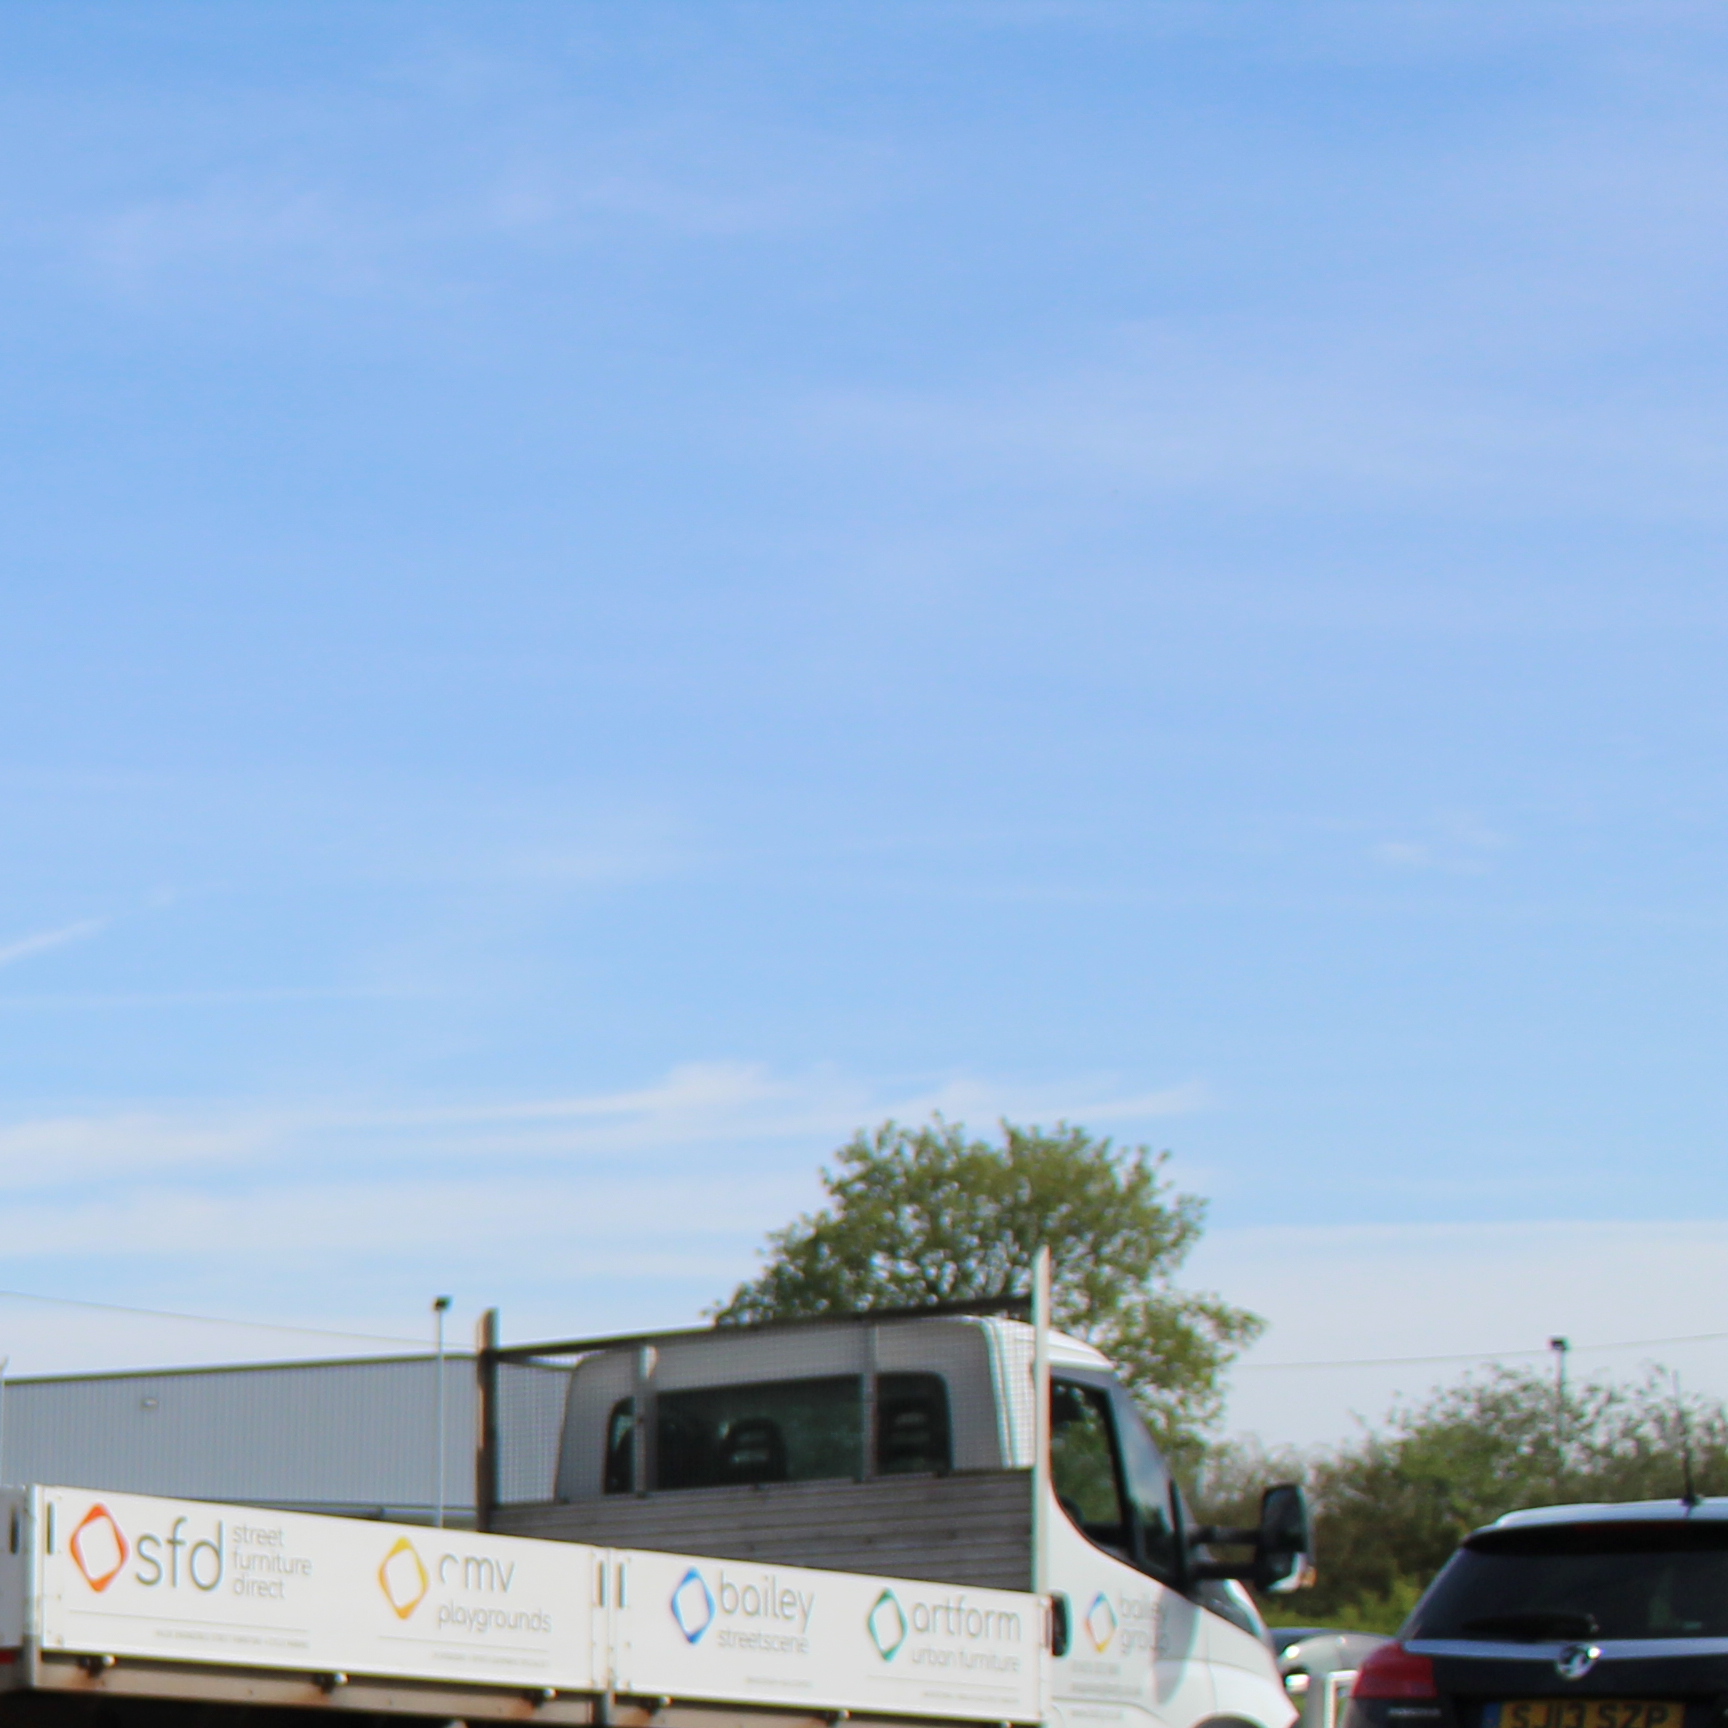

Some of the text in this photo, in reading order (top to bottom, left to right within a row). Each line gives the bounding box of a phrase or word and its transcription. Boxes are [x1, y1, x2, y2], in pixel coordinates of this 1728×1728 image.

[232, 1524, 285, 1548] street
[135, 1515, 225, 1592] sfd
[232, 1550, 313, 1576] furniture
[232, 1574, 286, 1600] direct
[718, 1569, 815, 1634] bailey
[437, 1599, 553, 1633] playgrounds
[912, 1594, 1022, 1642] artform
